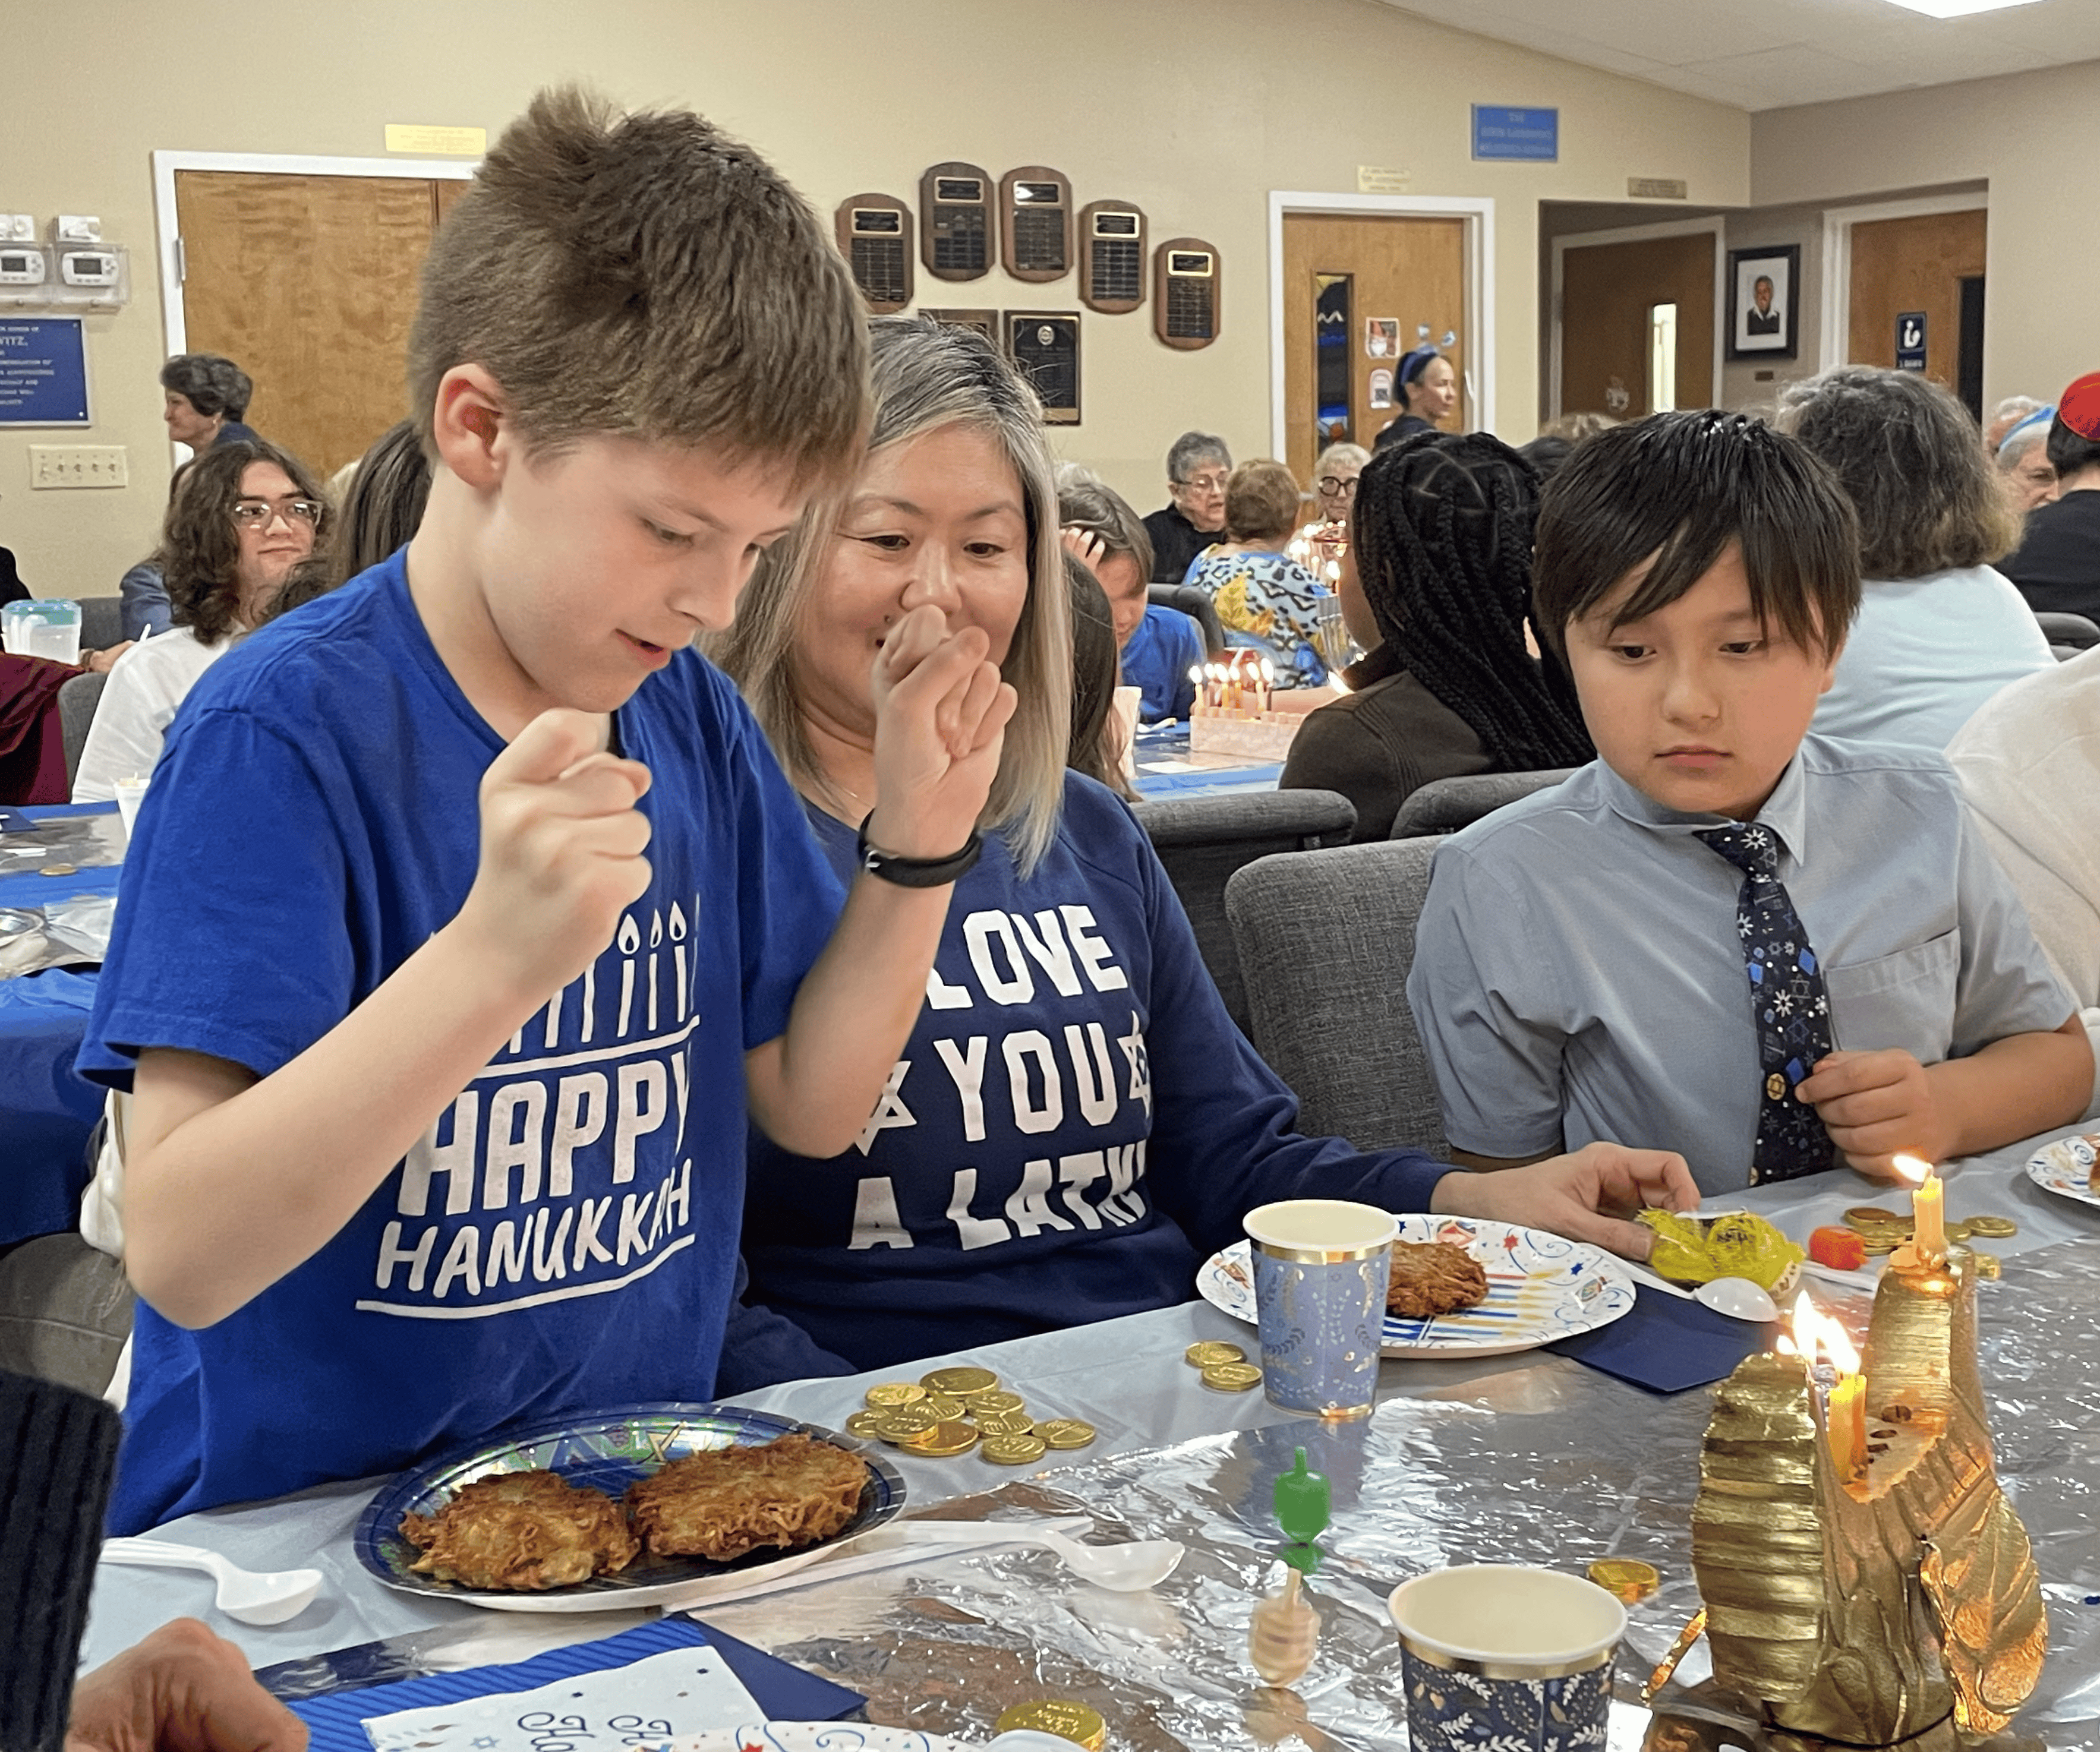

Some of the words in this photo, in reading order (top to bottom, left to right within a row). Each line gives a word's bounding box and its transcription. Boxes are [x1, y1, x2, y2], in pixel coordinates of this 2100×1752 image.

[396, 1046, 690, 1216] HAPPY
[934, 1022, 1118, 1142] YOU
[376, 1158, 692, 1298] HANUKKAH
[847, 1176, 915, 1251] A
